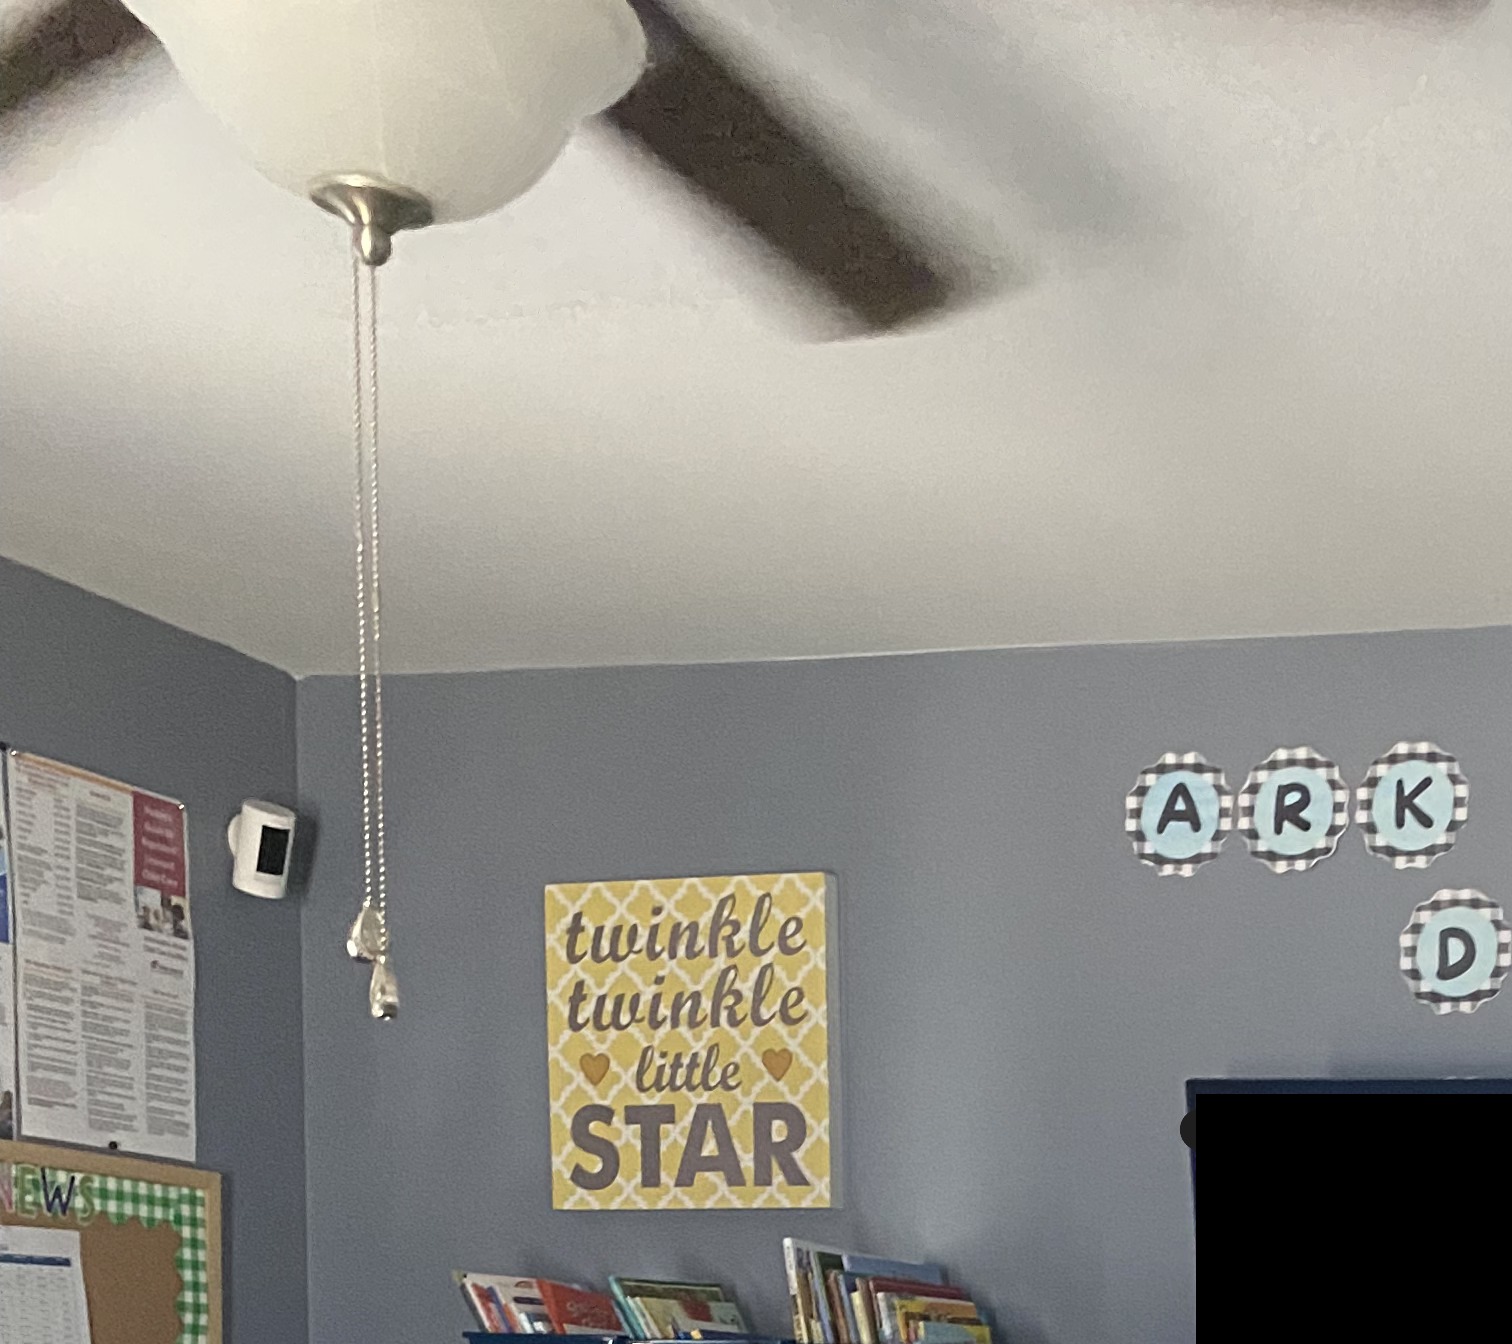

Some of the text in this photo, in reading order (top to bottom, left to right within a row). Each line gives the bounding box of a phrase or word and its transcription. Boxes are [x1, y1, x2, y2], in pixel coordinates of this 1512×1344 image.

[565, 891, 808, 965] twinkle
[567, 962, 810, 1033] twinkle
[635, 1042, 743, 1093] little
[568, 1101, 811, 1191] STAR
